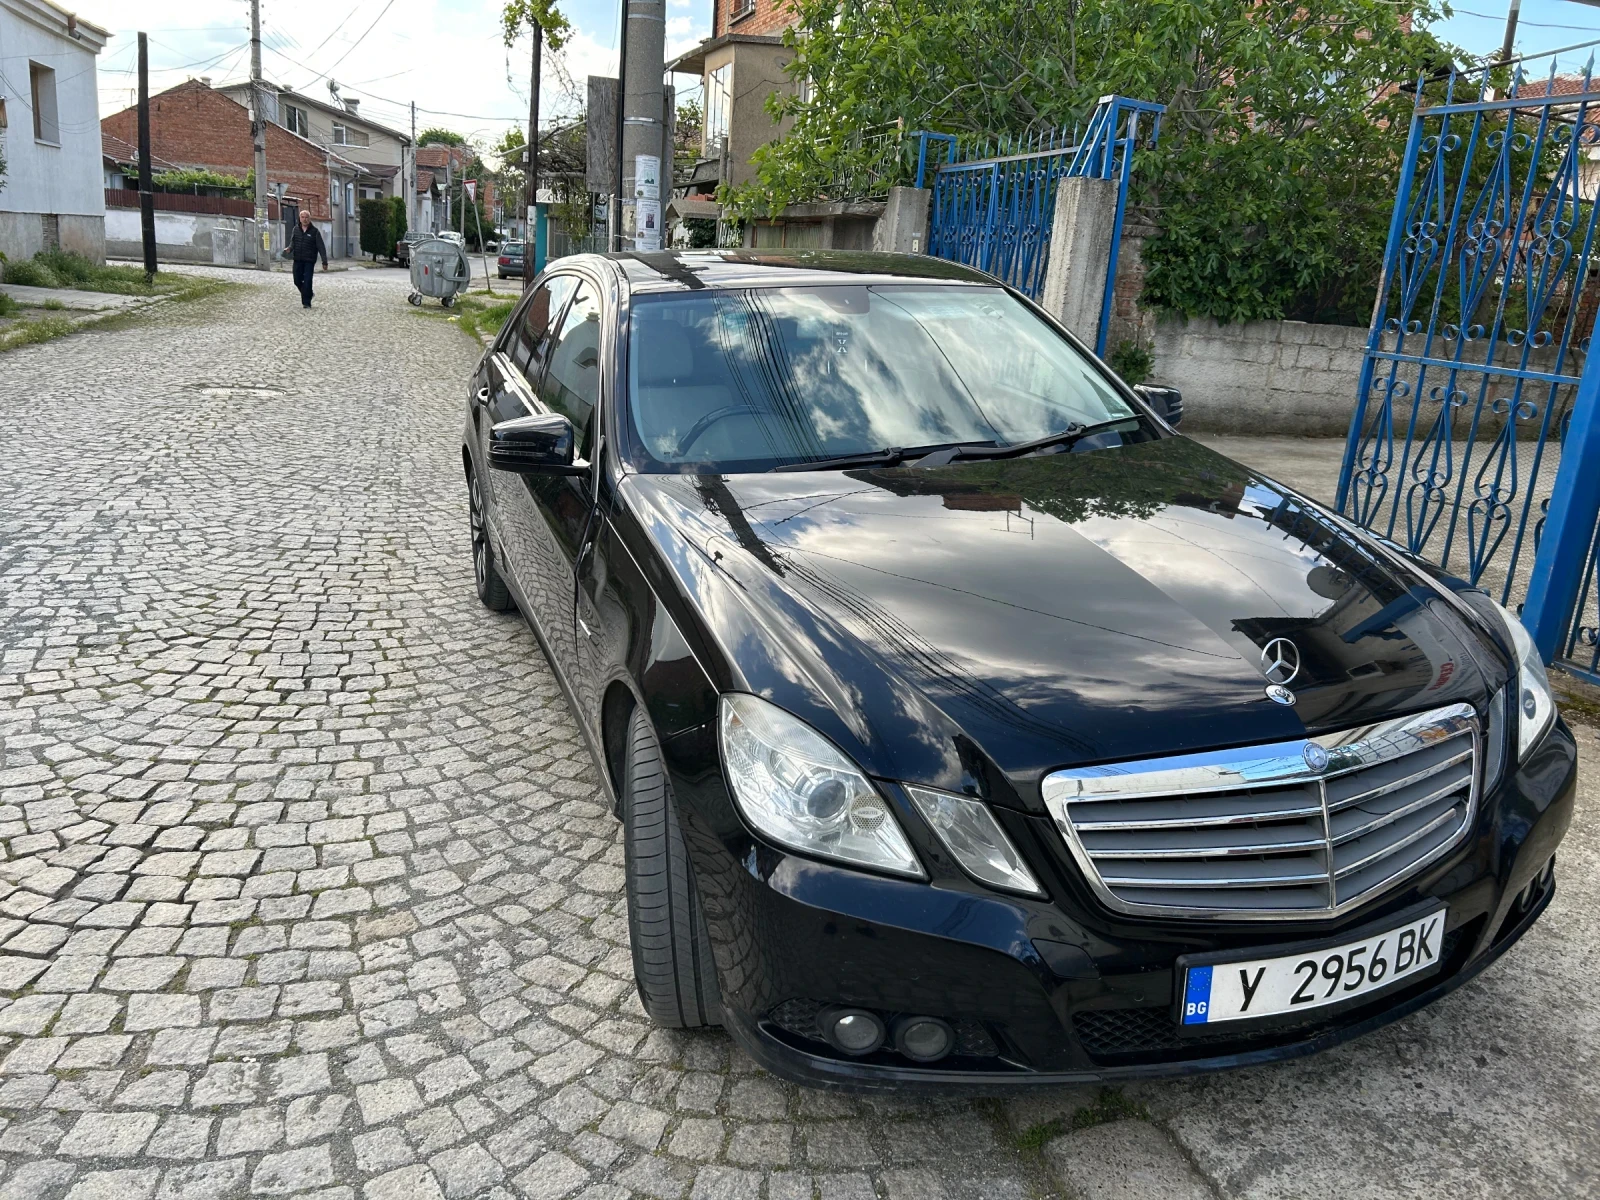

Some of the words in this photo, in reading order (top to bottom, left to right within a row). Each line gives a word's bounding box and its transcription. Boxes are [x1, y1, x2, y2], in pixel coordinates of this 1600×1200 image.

[1290, 939, 1388, 1005] 2956
[1394, 917, 1438, 975] BK
[1186, 1002, 1207, 1016] BG
